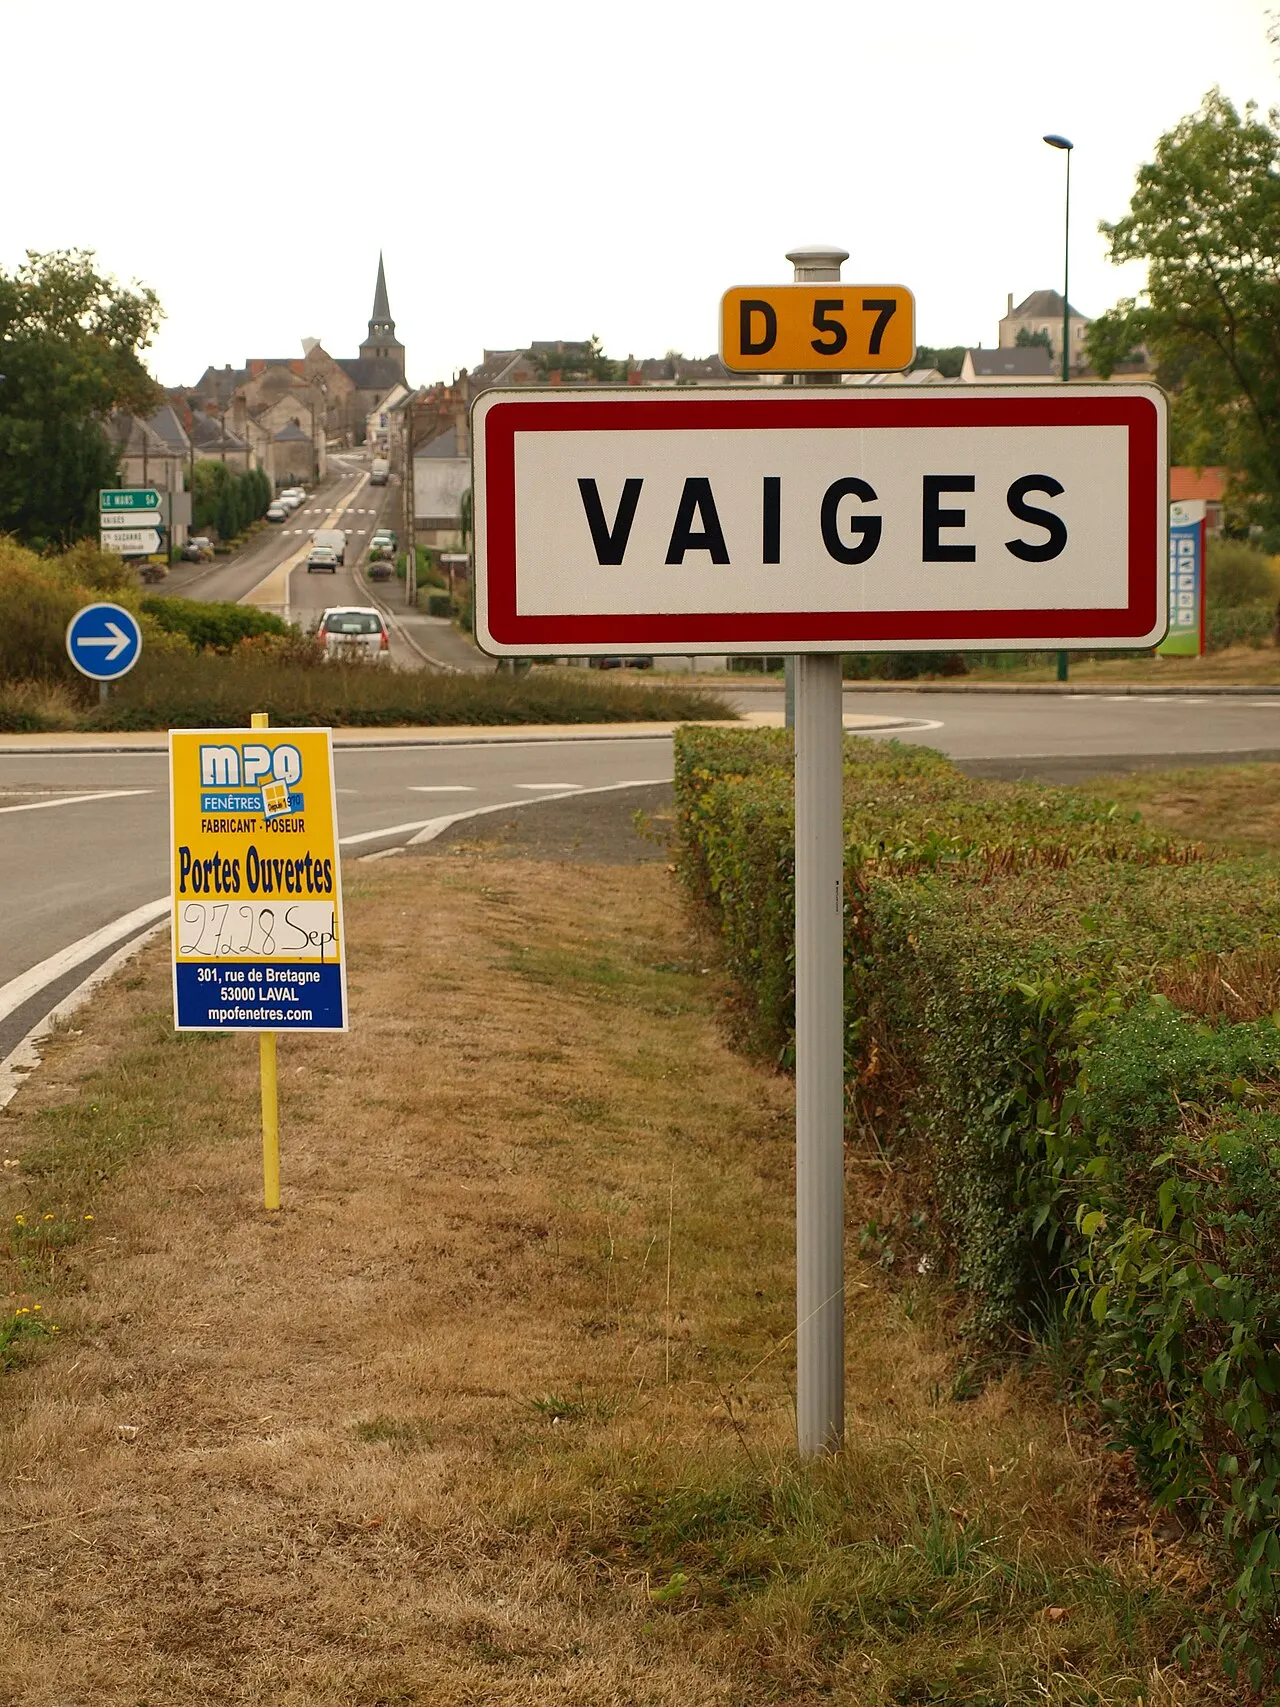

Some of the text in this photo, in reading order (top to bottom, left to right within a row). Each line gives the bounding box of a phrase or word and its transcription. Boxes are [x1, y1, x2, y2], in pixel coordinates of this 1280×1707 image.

[740, 300, 897, 355] D 57
[114, 494, 133, 505] MANS
[578, 474, 1068, 565] VAIGES
[204, 794, 261, 810] FENÊTRES
[283, 794, 301, 809] 1970
[201, 818, 256, 833] FABRICANT
[265, 818, 305, 833] POSEUR
[178, 844, 332, 894] Portes Ouvertes
[281, 905, 339, 963] Sept
[197, 967, 321, 986] 301, rue de Bretagne
[220, 987, 300, 1001] 53000 LAVAL
[208, 1006, 313, 1023] mpofenetres.com
